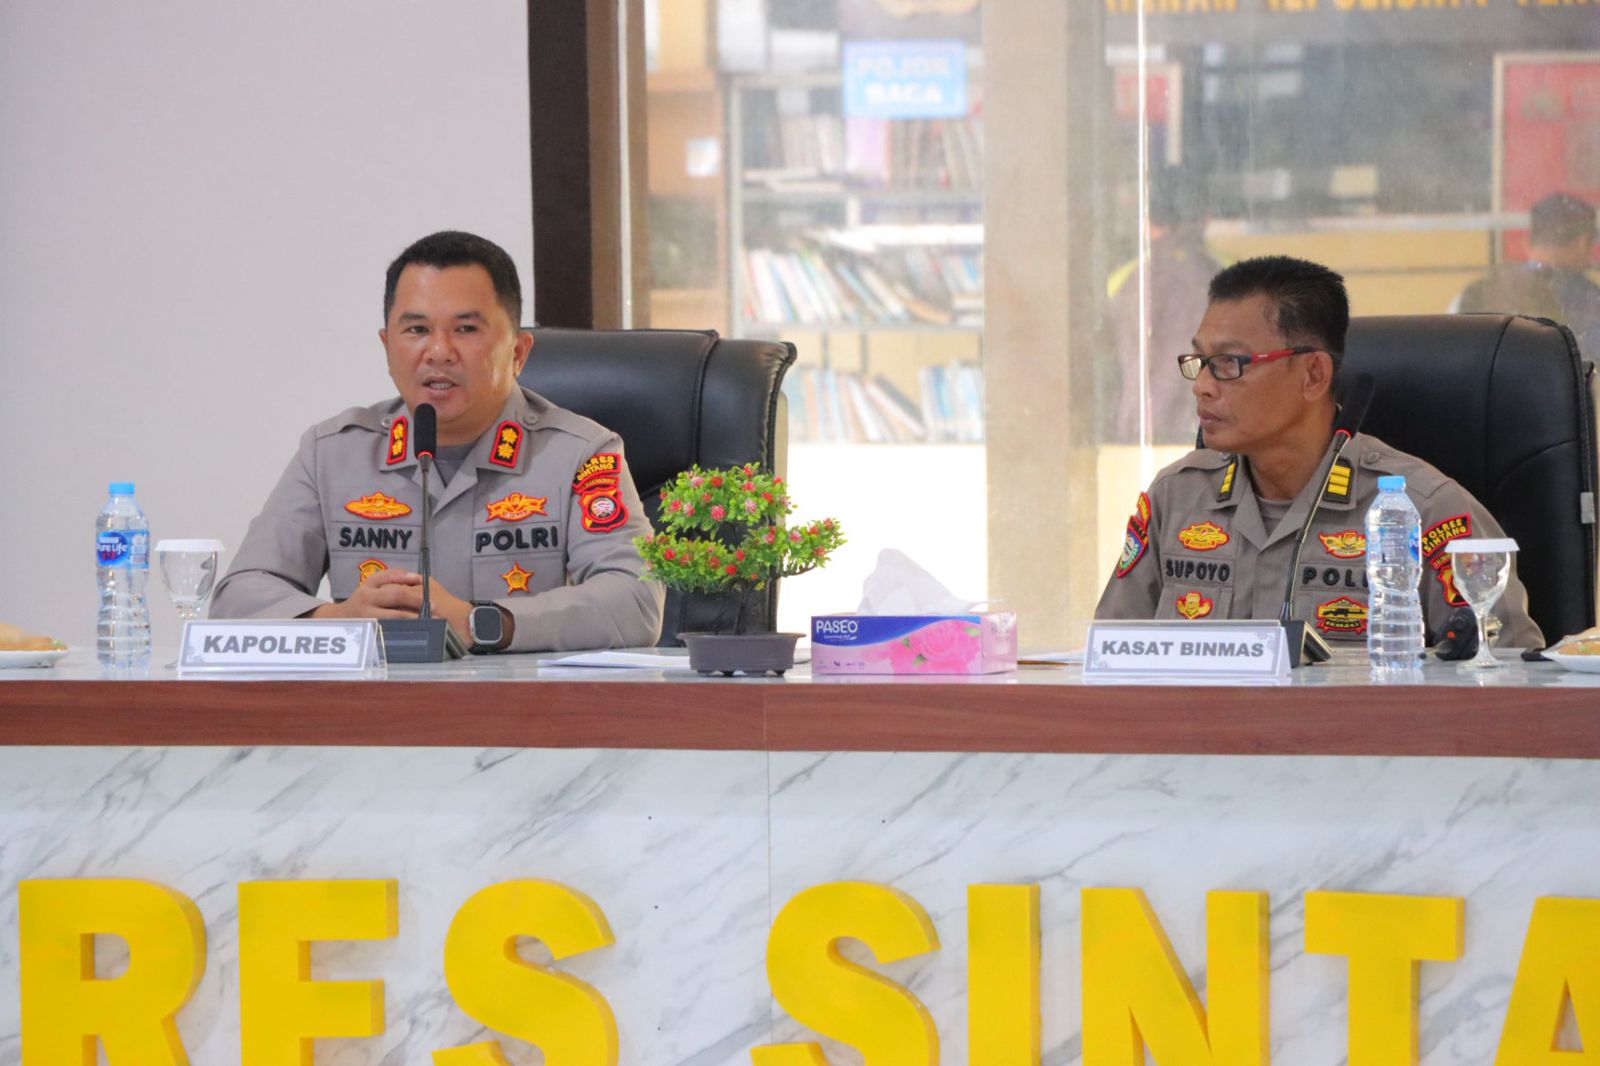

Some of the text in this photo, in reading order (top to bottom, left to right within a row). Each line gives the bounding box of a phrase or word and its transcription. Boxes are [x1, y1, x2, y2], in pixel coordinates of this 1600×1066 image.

[865, 81, 942, 104] BACA
[339, 526, 413, 550] SANNY
[475, 526, 559, 553] POLRI
[1422, 518, 1462, 544] POLRES
[1424, 526, 1466, 552] SINTANG
[1166, 559, 1230, 582] SUPOYO
[1302, 567, 1369, 587] POL
[816, 619, 858, 634] PASEO
[203, 635, 347, 655] KAPOLRES
[1102, 641, 1264, 657] KASAT BINMAS
